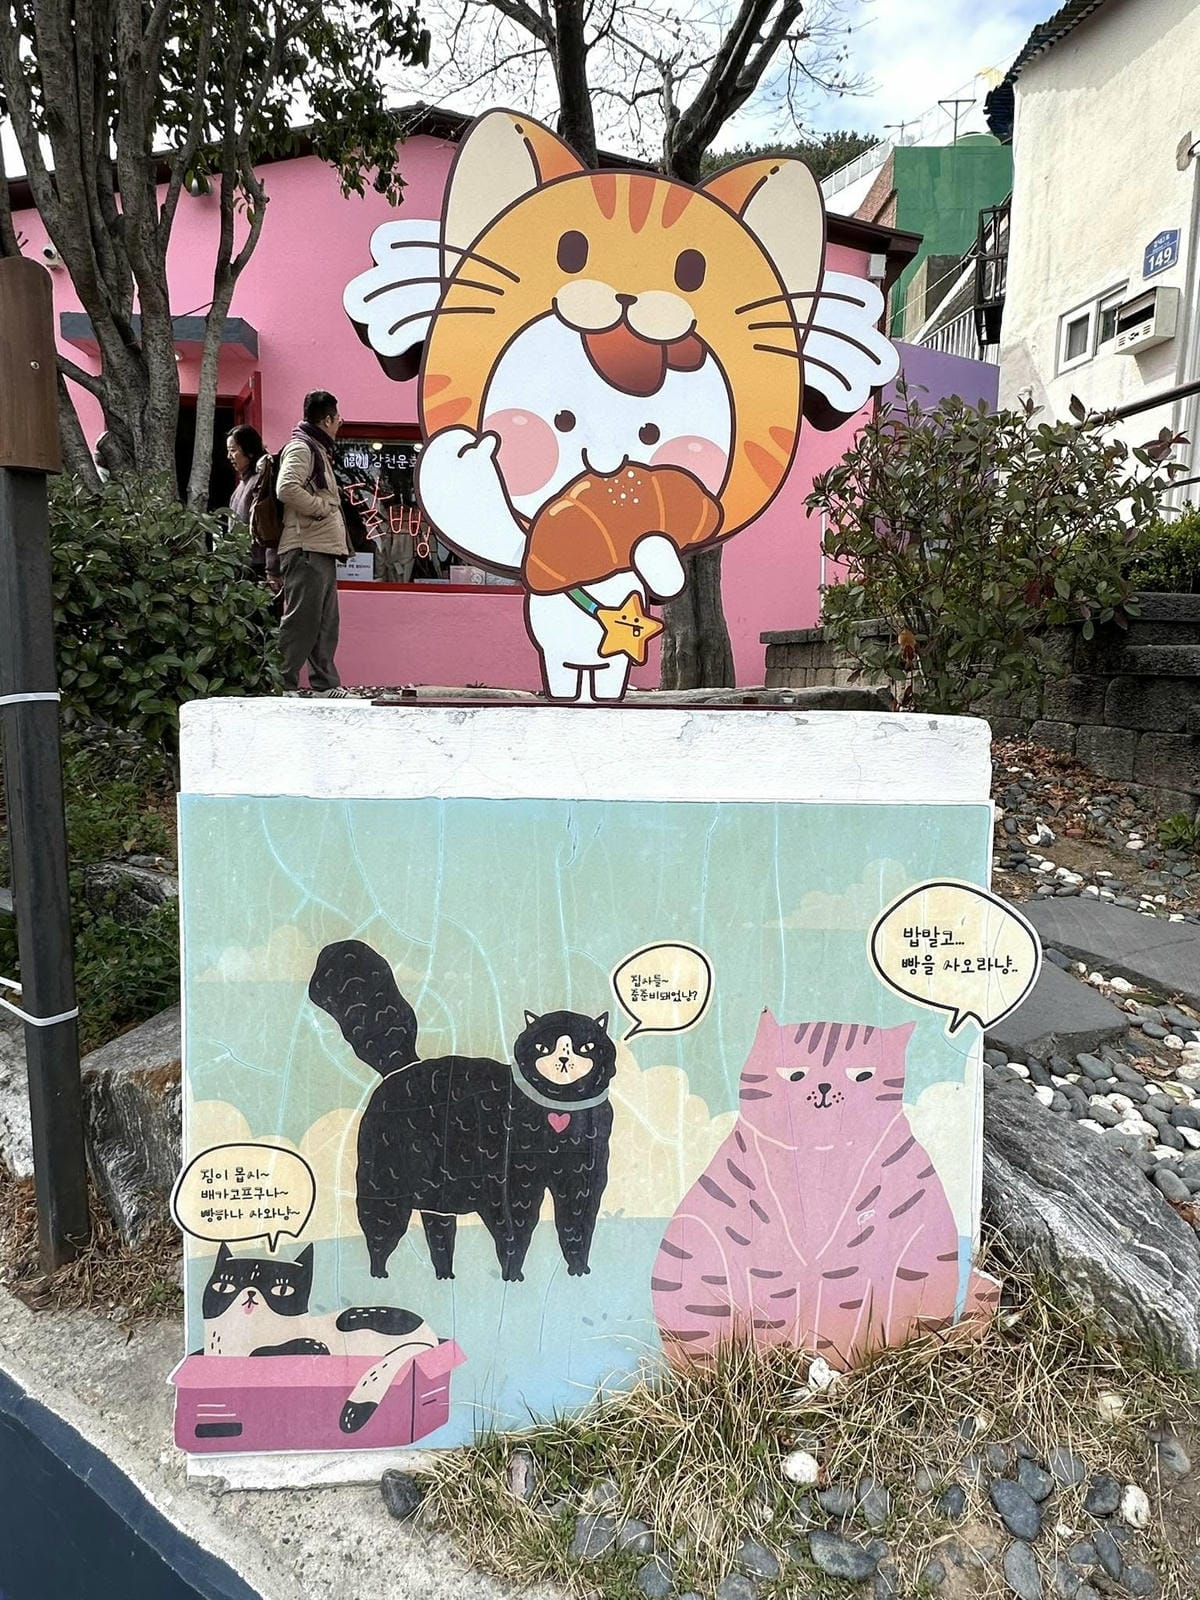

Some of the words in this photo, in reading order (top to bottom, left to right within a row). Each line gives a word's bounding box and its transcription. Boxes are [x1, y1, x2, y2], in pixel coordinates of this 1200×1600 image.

[1148, 247, 1172, 271] 149
[903, 926, 965, 948] 밥말고...
[902, 954, 935, 975] 빵을
[943, 955, 1018, 975] 사오라냥..
[631, 974, 669, 987] 집사들~
[235, 1166, 270, 1183] 몹시~
[200, 1187, 289, 1201] 배가고프구나~
[200, 1207, 244, 1222] 빵하나
[249, 1206, 300, 1221] 사와냥~
